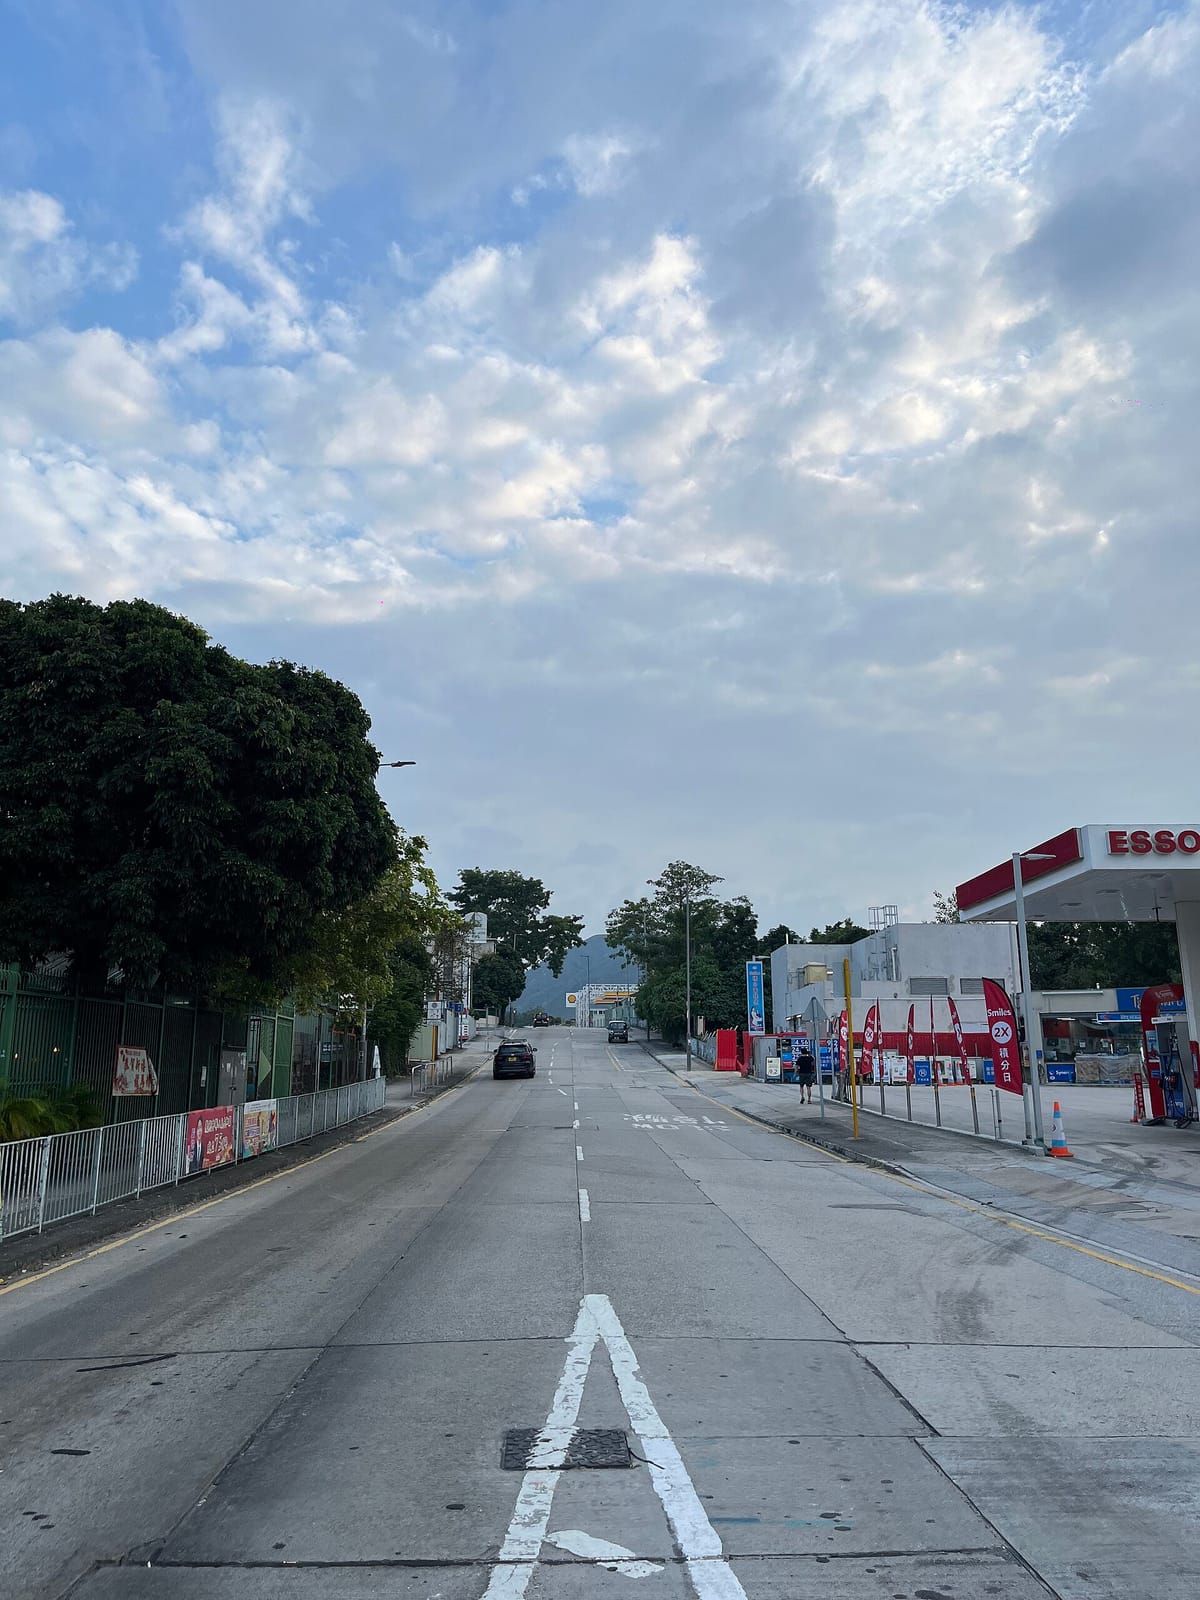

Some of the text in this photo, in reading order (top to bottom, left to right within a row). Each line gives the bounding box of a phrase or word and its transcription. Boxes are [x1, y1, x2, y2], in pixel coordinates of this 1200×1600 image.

[1107, 829, 1200, 855] ESSO
[987, 1007, 1012, 1017] Smiles
[994, 1026, 1009, 1038] 2X
[999, 1047, 1011, 1082] 積分日
